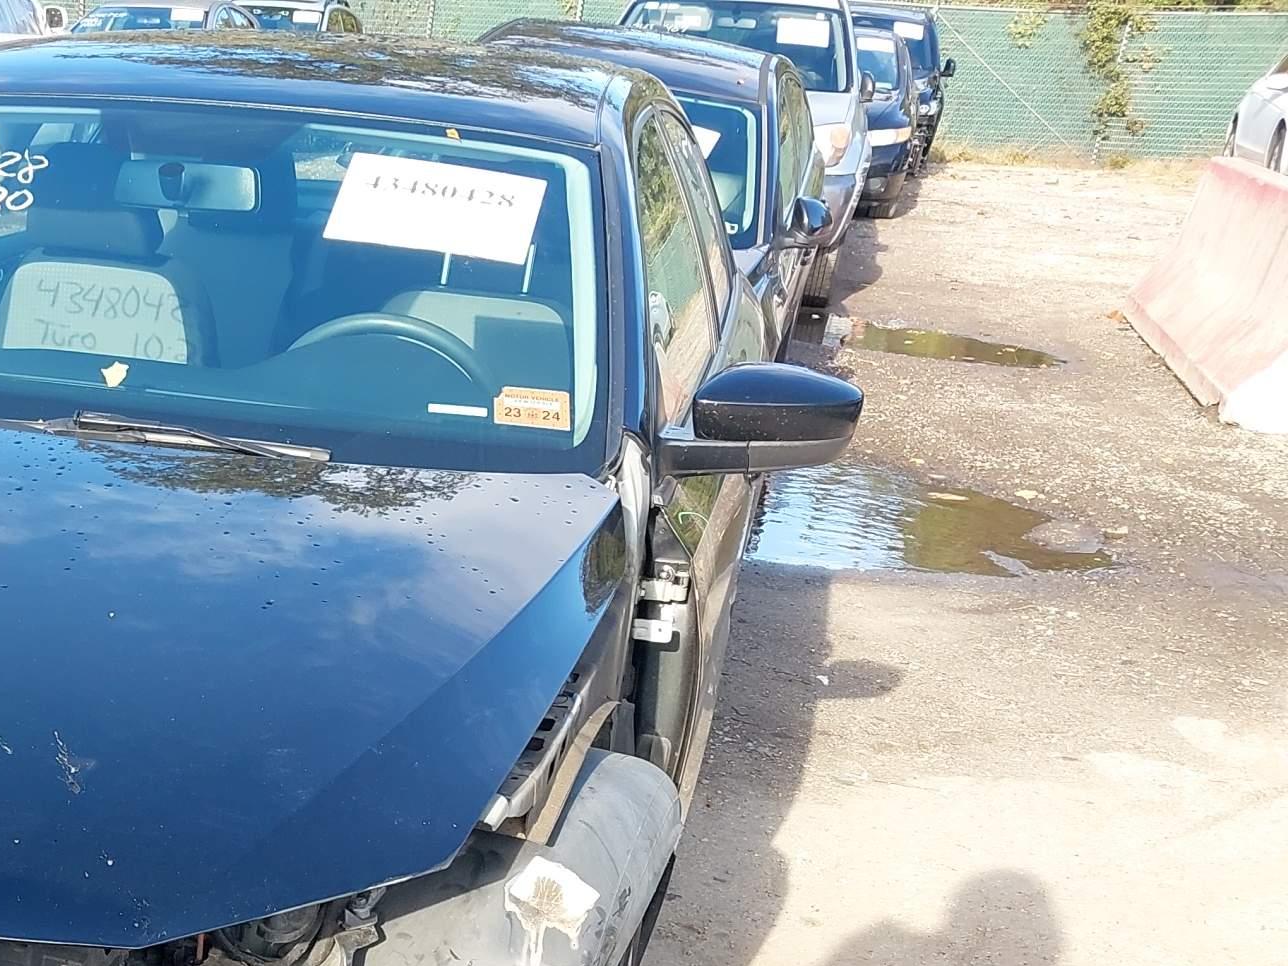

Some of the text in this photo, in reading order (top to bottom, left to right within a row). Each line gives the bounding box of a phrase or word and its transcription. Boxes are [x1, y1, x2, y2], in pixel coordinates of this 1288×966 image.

[365, 175, 516, 208] 43480428
[504, 406, 521, 418] 23
[542, 410, 560, 421] 24
